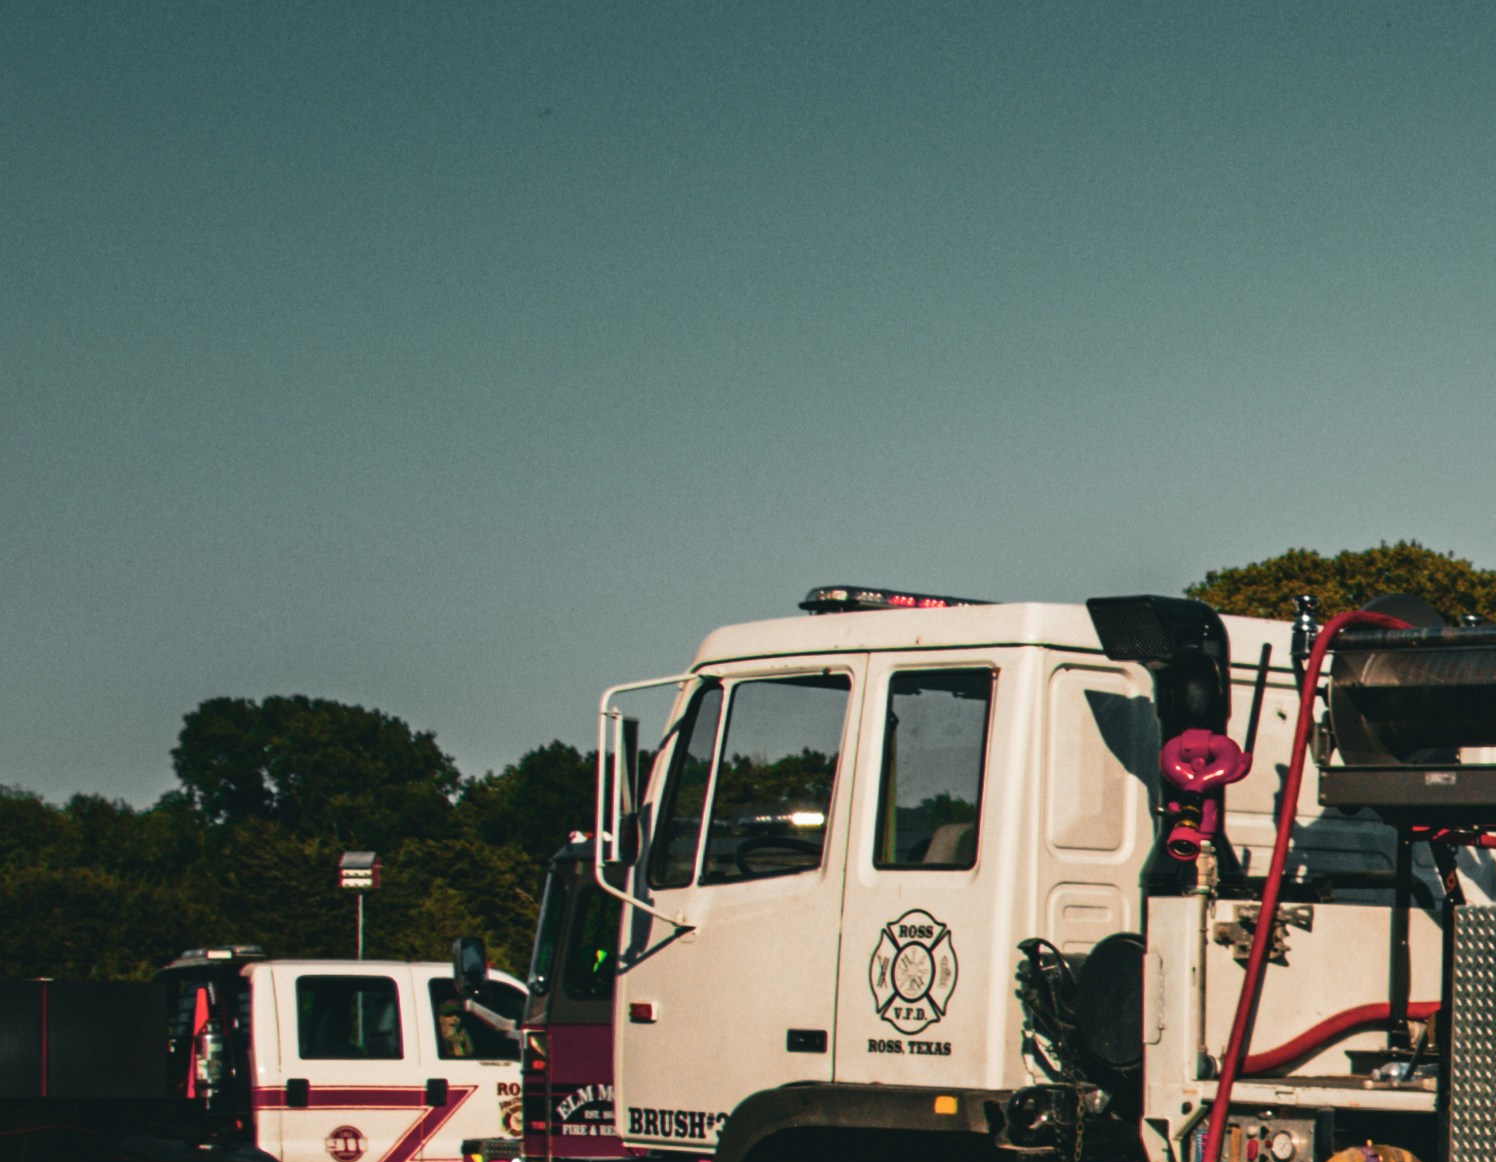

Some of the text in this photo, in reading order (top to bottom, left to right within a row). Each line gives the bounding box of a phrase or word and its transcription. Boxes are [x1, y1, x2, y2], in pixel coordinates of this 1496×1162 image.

[899, 924, 934, 939] ROSS
[893, 1007, 928, 1021] V.F.D.
[907, 1040, 952, 1056] TEXAS
[556, 1084, 594, 1120] ELM
[562, 1124, 588, 1136] FIRE
